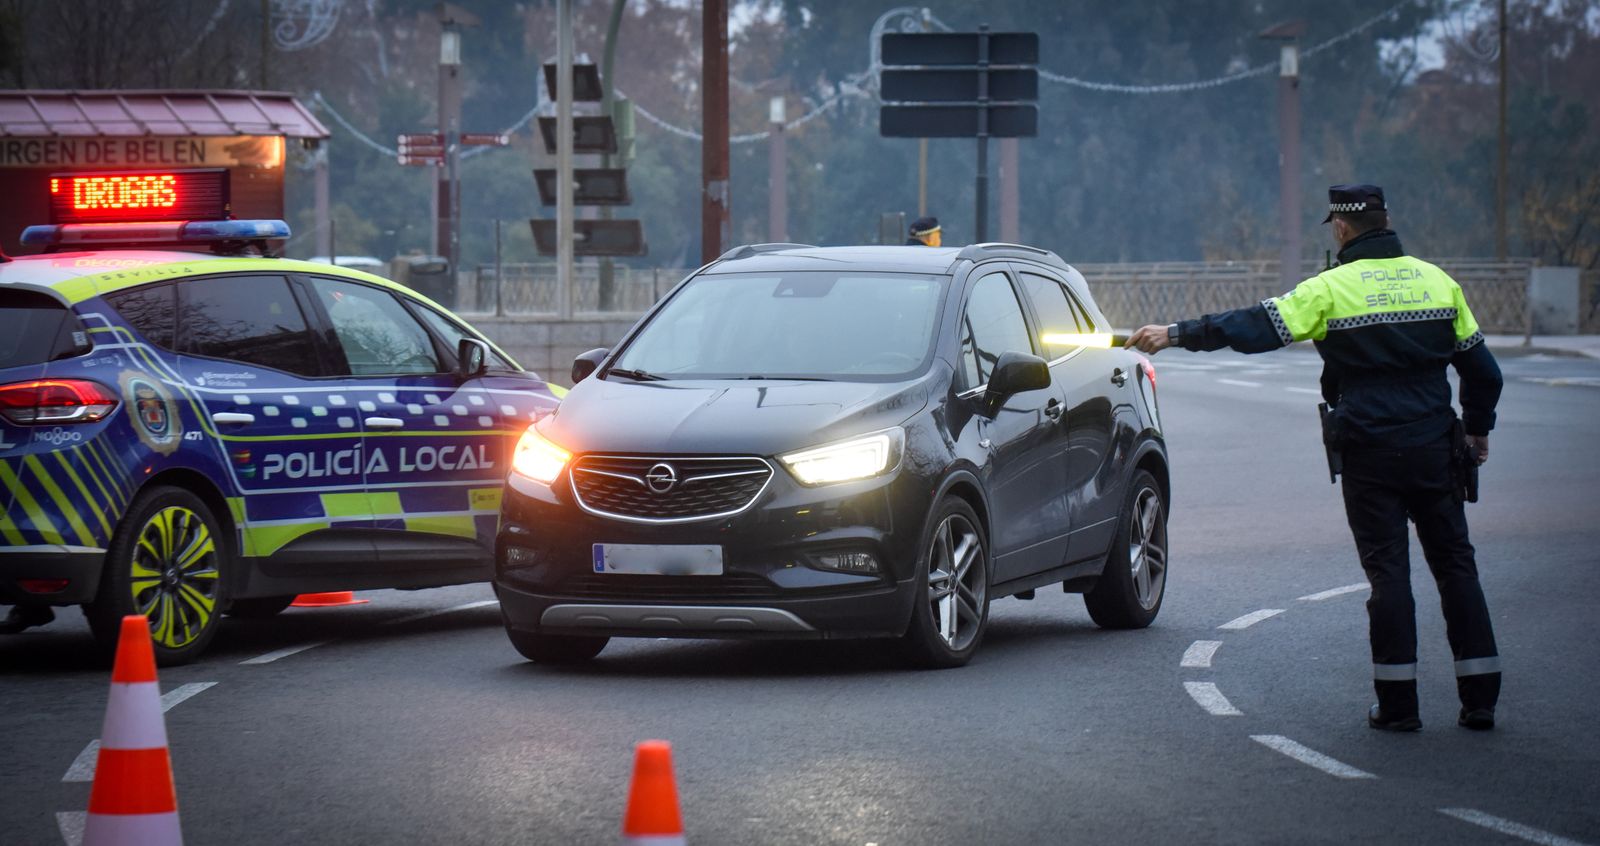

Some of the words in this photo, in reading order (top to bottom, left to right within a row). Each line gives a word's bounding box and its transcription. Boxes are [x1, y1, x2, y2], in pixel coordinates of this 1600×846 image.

[84, 140, 117, 163] DE
[125, 139, 206, 163] BELEN
[74, 175, 176, 209] DROGAS
[101, 267, 193, 281] SEVILLA
[1361, 268, 1424, 283] POLICIA
[1380, 283, 1412, 291] LOCAL
[1365, 290, 1433, 308] SEVILLA
[184, 430, 203, 441] 471
[263, 442, 389, 480] POLICÍA
[400, 444, 494, 472] LOCAL
